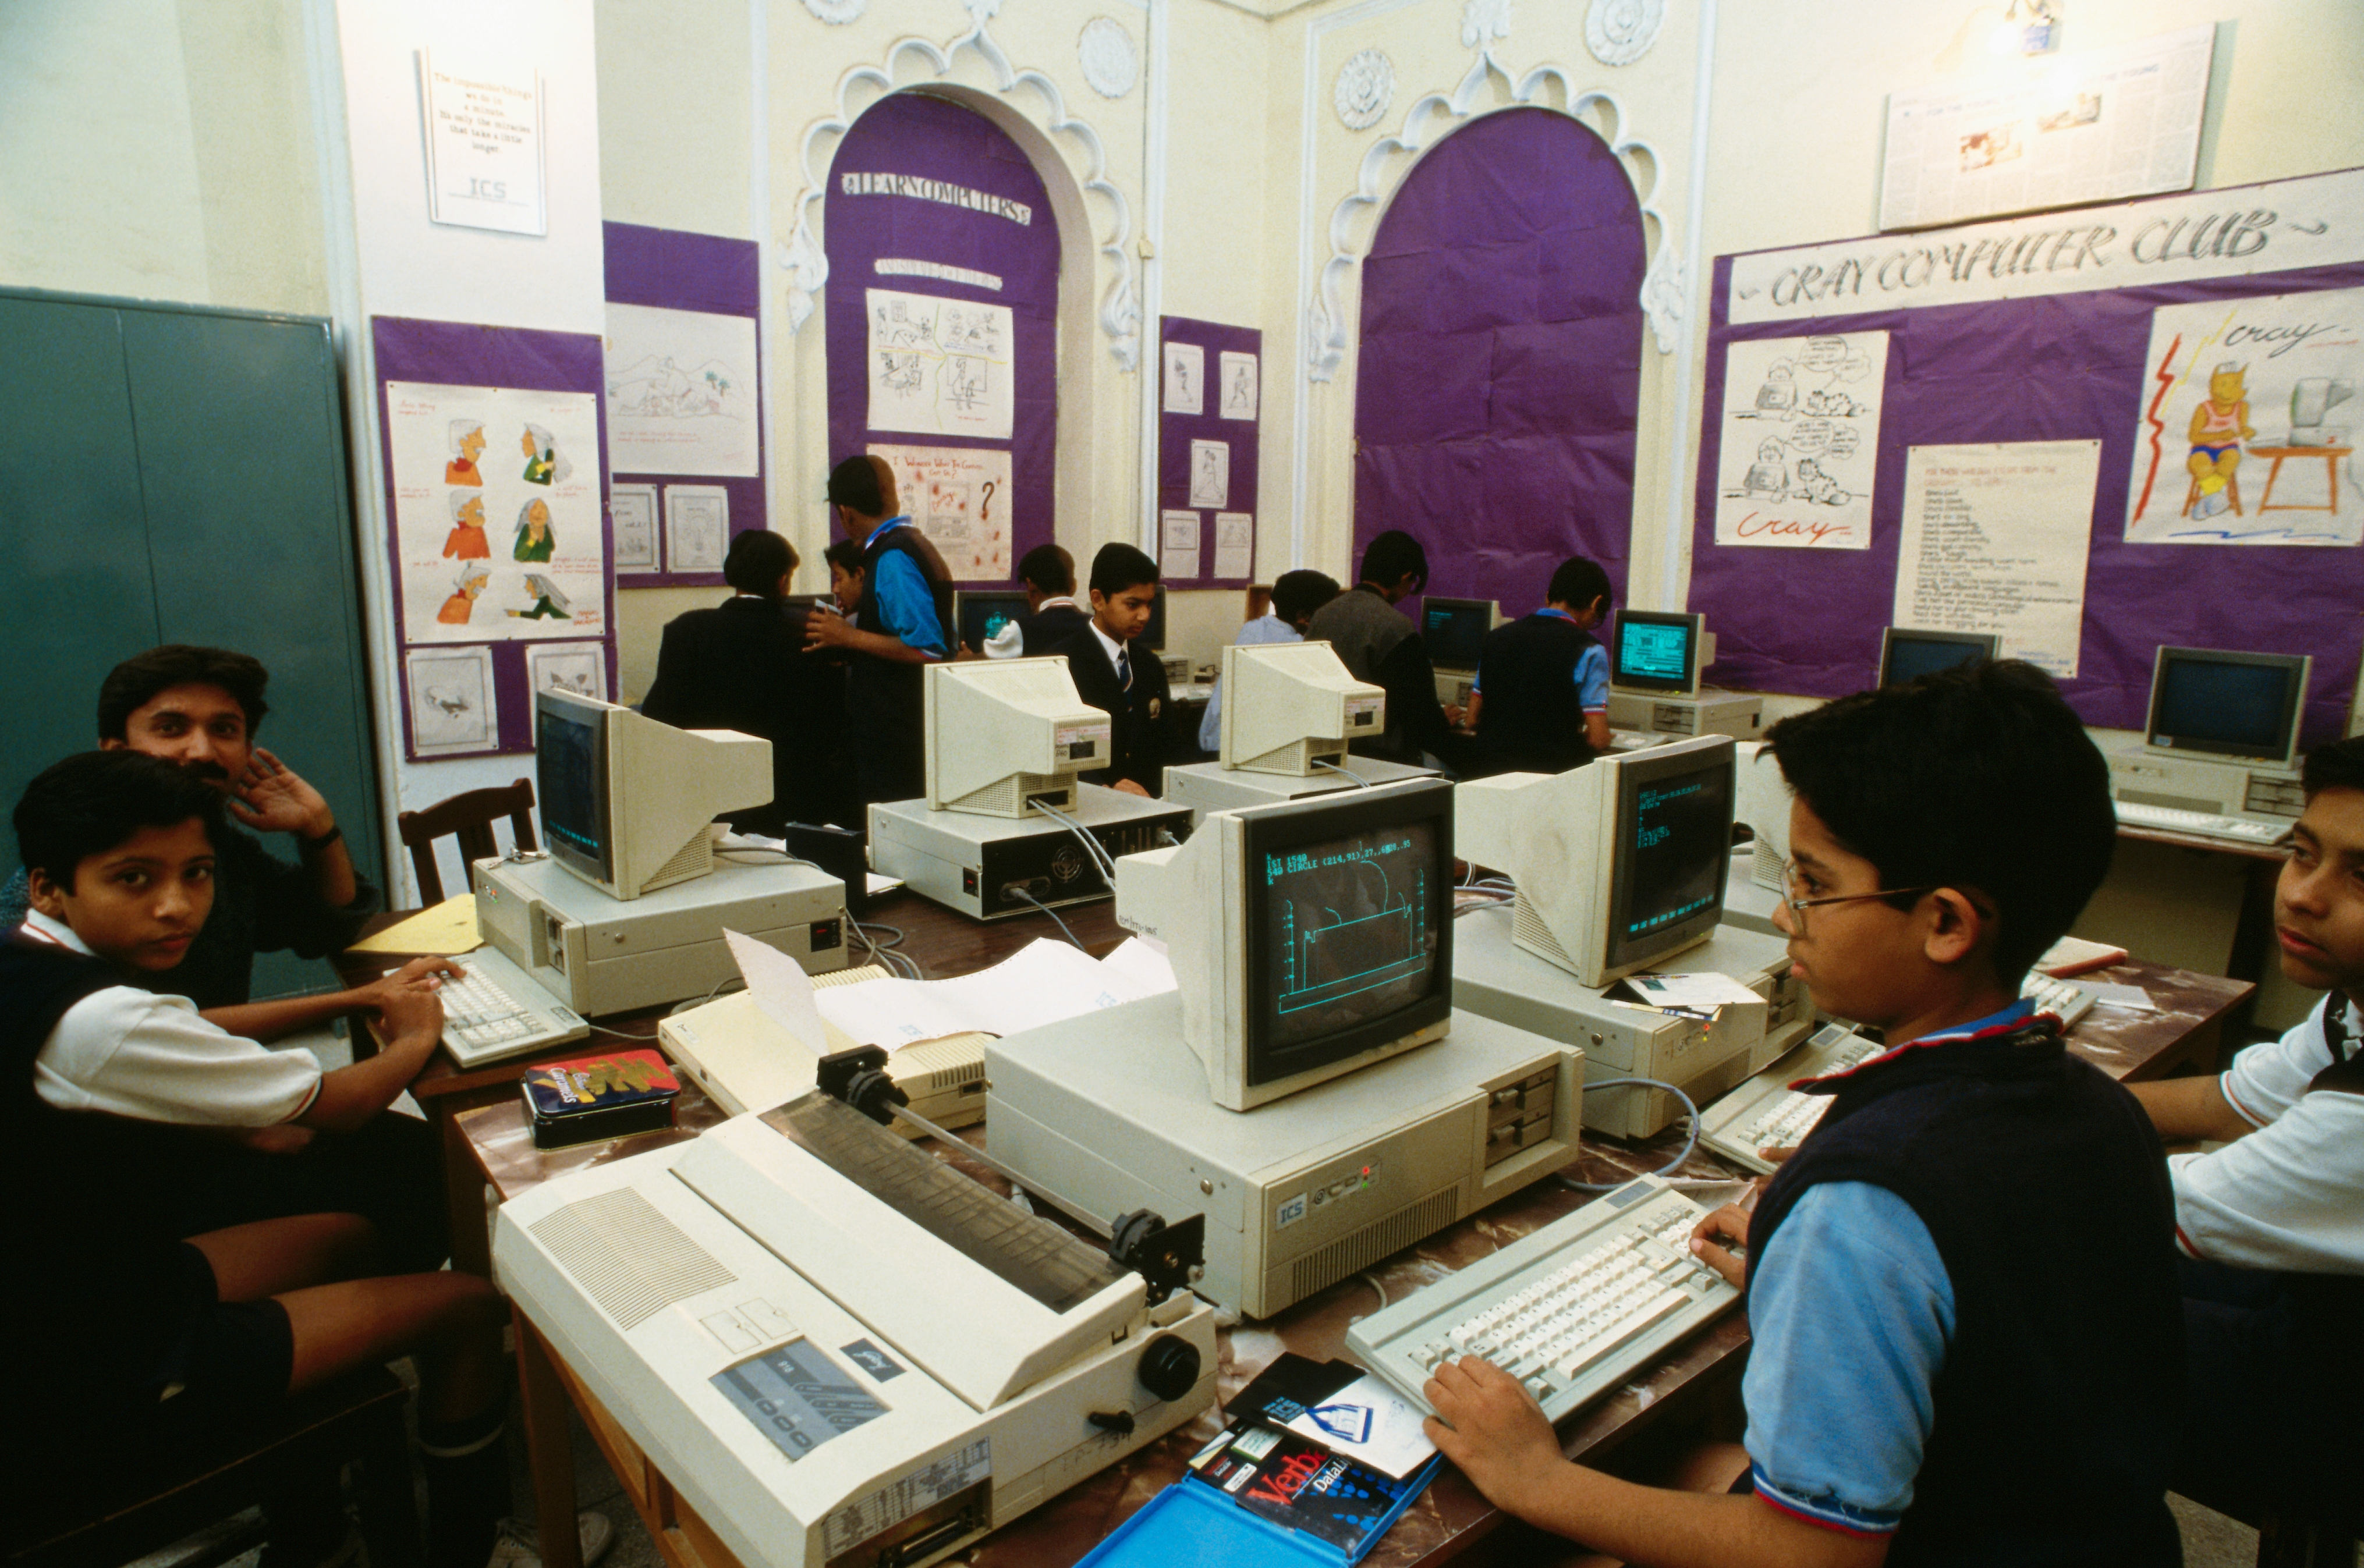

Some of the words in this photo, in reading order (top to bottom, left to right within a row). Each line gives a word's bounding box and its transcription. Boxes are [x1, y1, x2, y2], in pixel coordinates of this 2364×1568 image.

[435, 72, 450, 83] The
[455, 76, 500, 92] impossible
[481, 94, 490, 102] do
[455, 115, 472, 125] only
[477, 115, 490, 126] the
[495, 121, 531, 133] miracles
[450, 125, 467, 134] that
[472, 129, 490, 138] take
[501, 133, 522, 143] little
[470, 177, 506, 198] ICS
[1771, 254, 1877, 307] CRAY
[1878, 226, 2117, 291] COMPUTER
[2132, 208, 2278, 264] CLUB
[1287, 859, 1319, 873] CIRCLE
[1281, 1201, 1303, 1223] ICS
[1269, 1399, 1302, 1418] ICS
